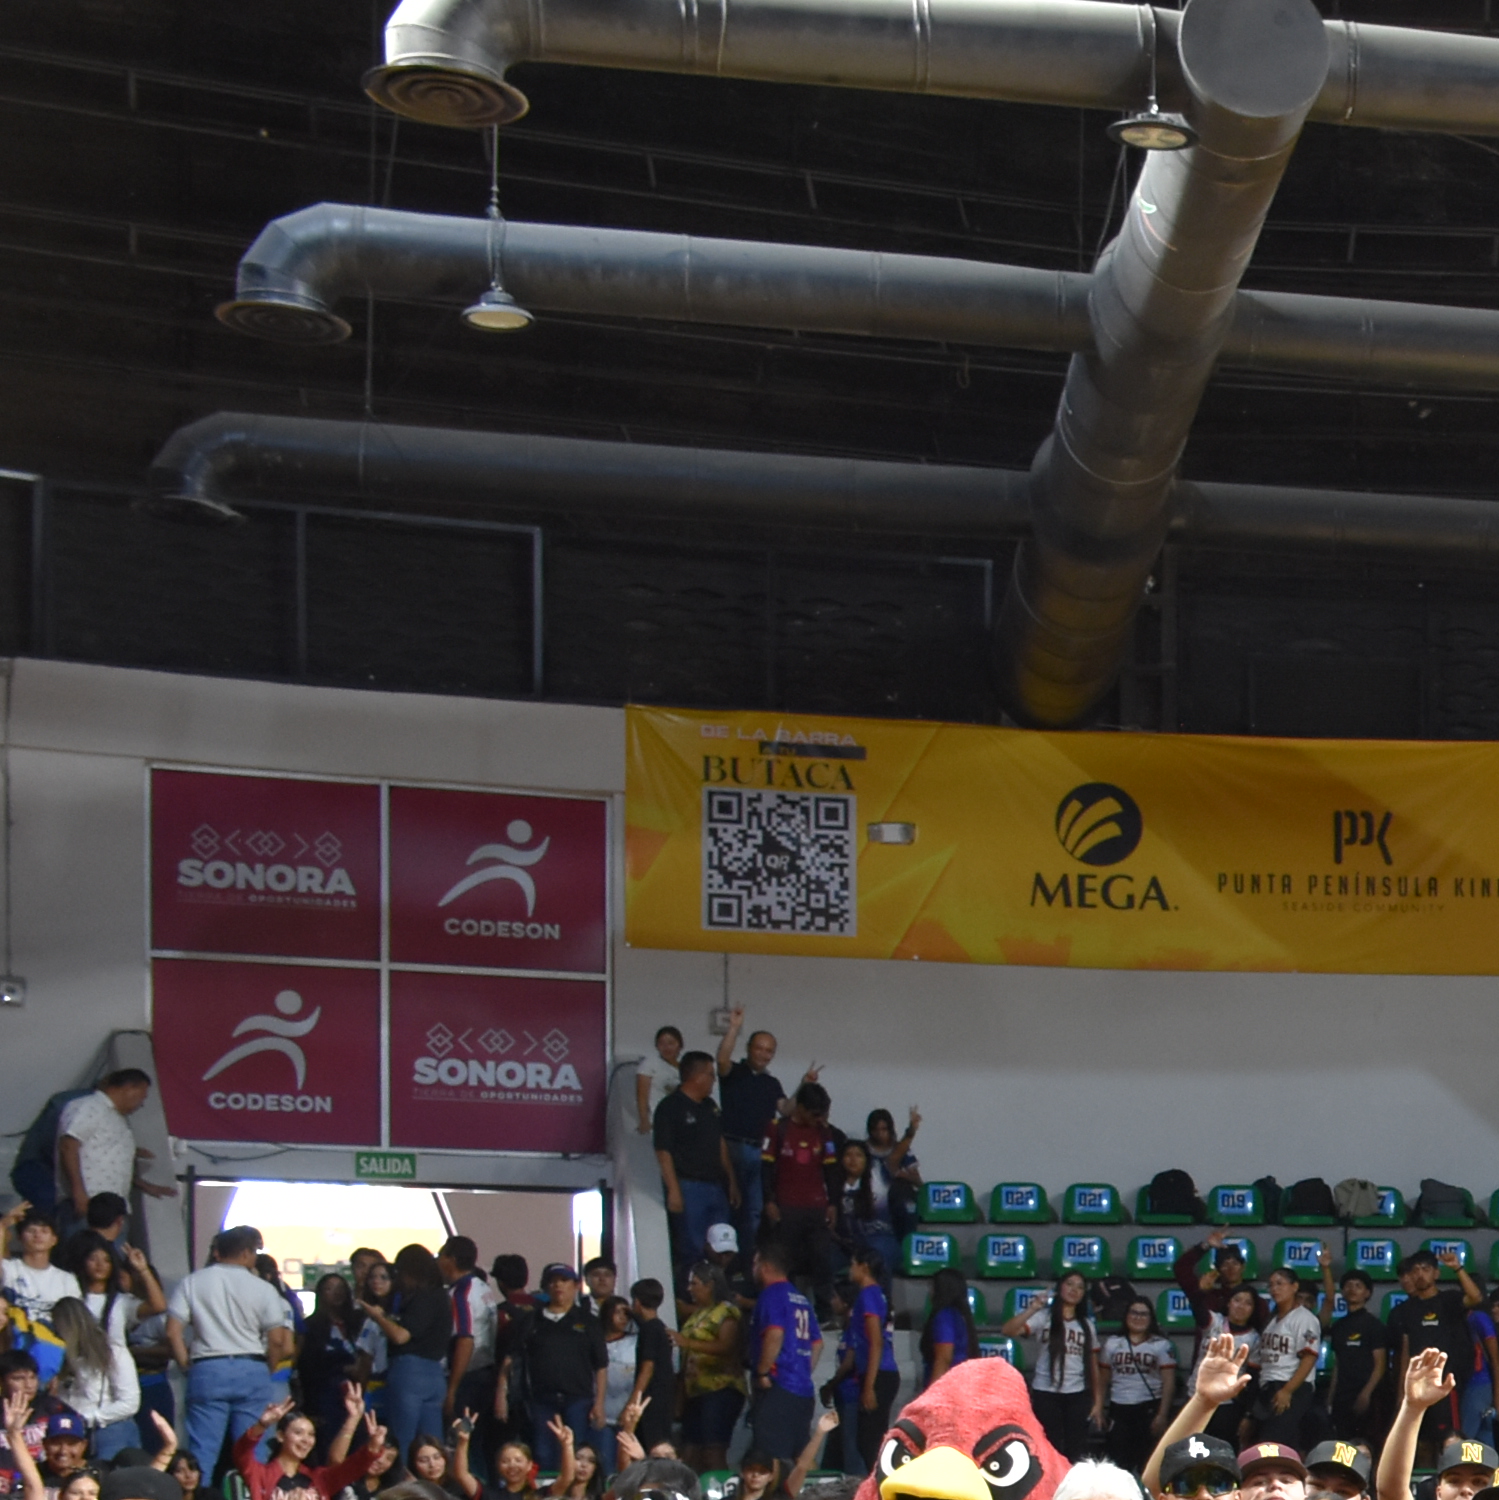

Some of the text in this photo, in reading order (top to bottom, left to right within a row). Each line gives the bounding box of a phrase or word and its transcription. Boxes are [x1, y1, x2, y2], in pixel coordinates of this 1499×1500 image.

[703, 755, 855, 790] BUTACA
[177, 858, 356, 895] SONORA
[1217, 873, 1292, 894] PUNTA
[1308, 872, 1438, 897] PENÍNSULA
[444, 918, 560, 940] CODESON
[413, 1056, 582, 1091] SONORA
[208, 1091, 332, 1113] CODESON
[480, 1091, 583, 1103] OPORTUNIDADES
[360, 1155, 412, 1177] SALIDA
[1288, 1245, 1312, 1262] 017
[1361, 1245, 1385, 1261] 016
[1258, 1443, 1279, 1458] N
[1332, 1441, 1356, 1467] N
[1462, 1442, 1482, 1463] N
